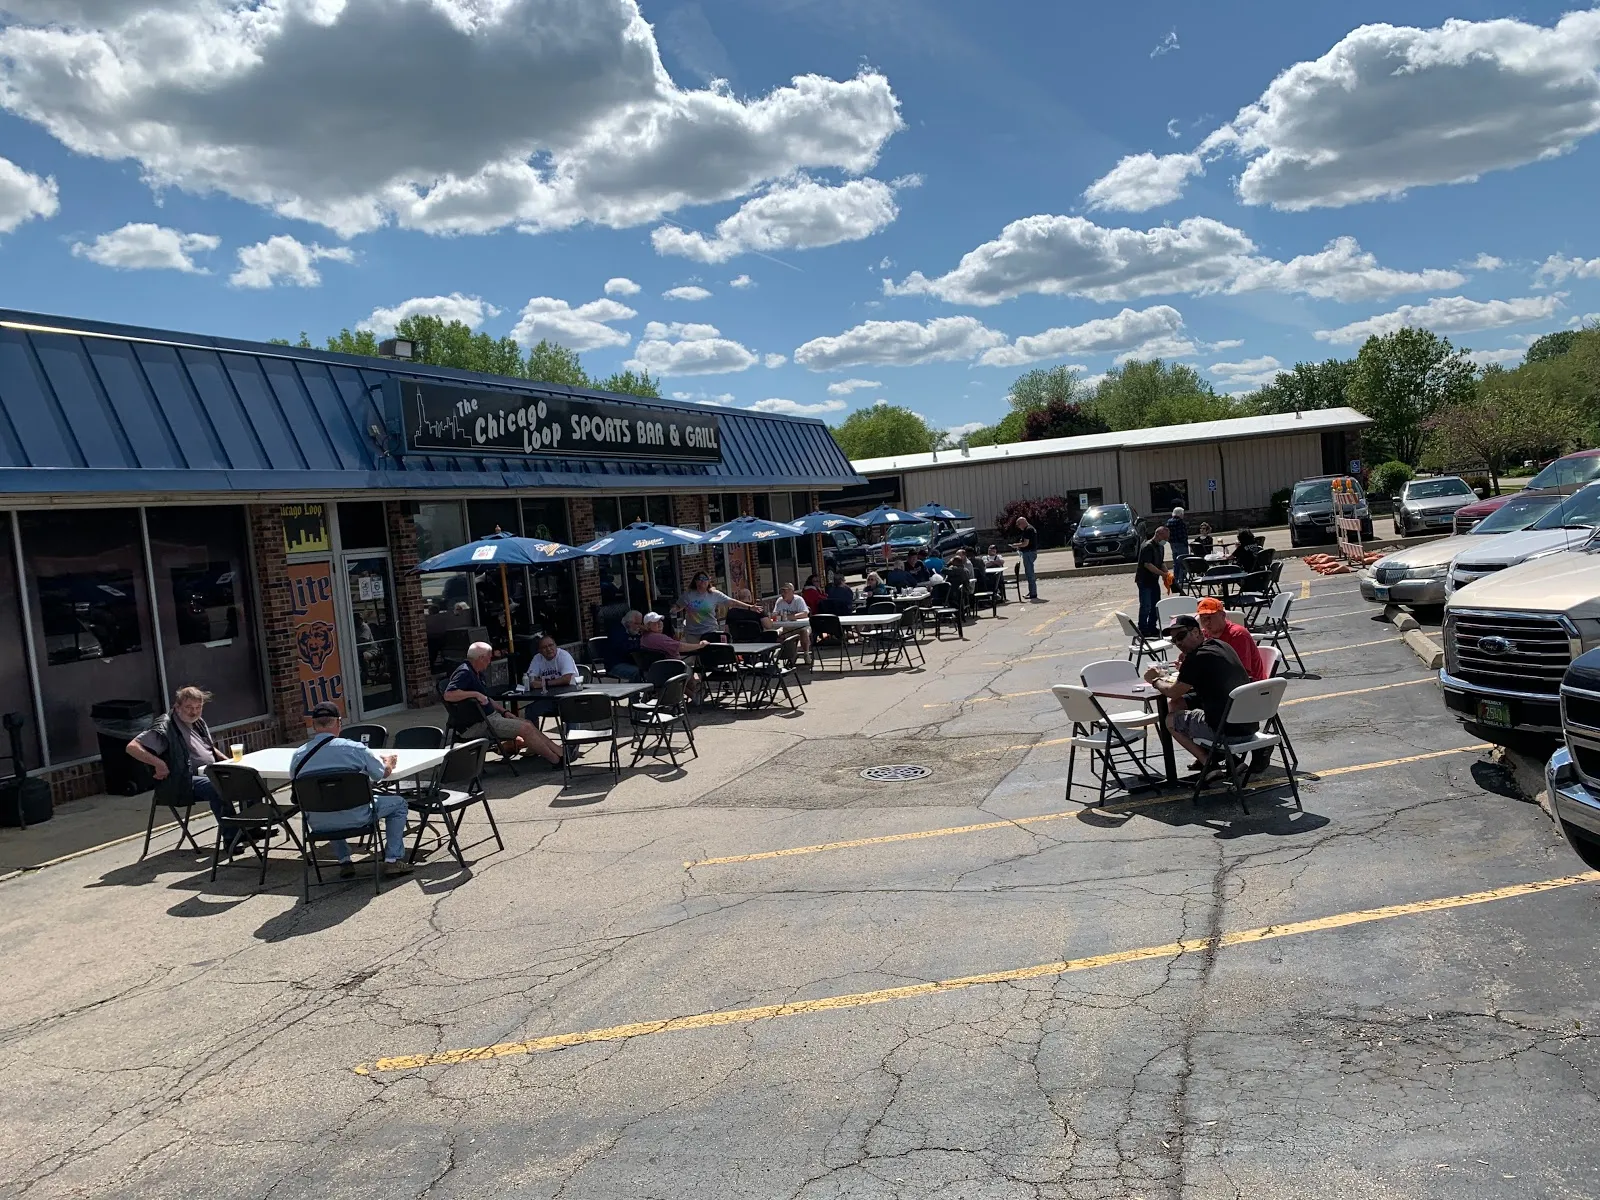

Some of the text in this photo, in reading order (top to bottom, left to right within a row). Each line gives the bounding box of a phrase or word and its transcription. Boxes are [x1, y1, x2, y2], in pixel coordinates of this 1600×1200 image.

[456, 397, 479, 418] The
[474, 399, 548, 445] Chicago
[523, 421, 562, 454] Loop
[570, 414, 718, 449] SPORTS BAR & GRILL
[304, 503, 322, 517] Loop
[289, 576, 331, 616] Lite
[301, 674, 343, 717] Lite
